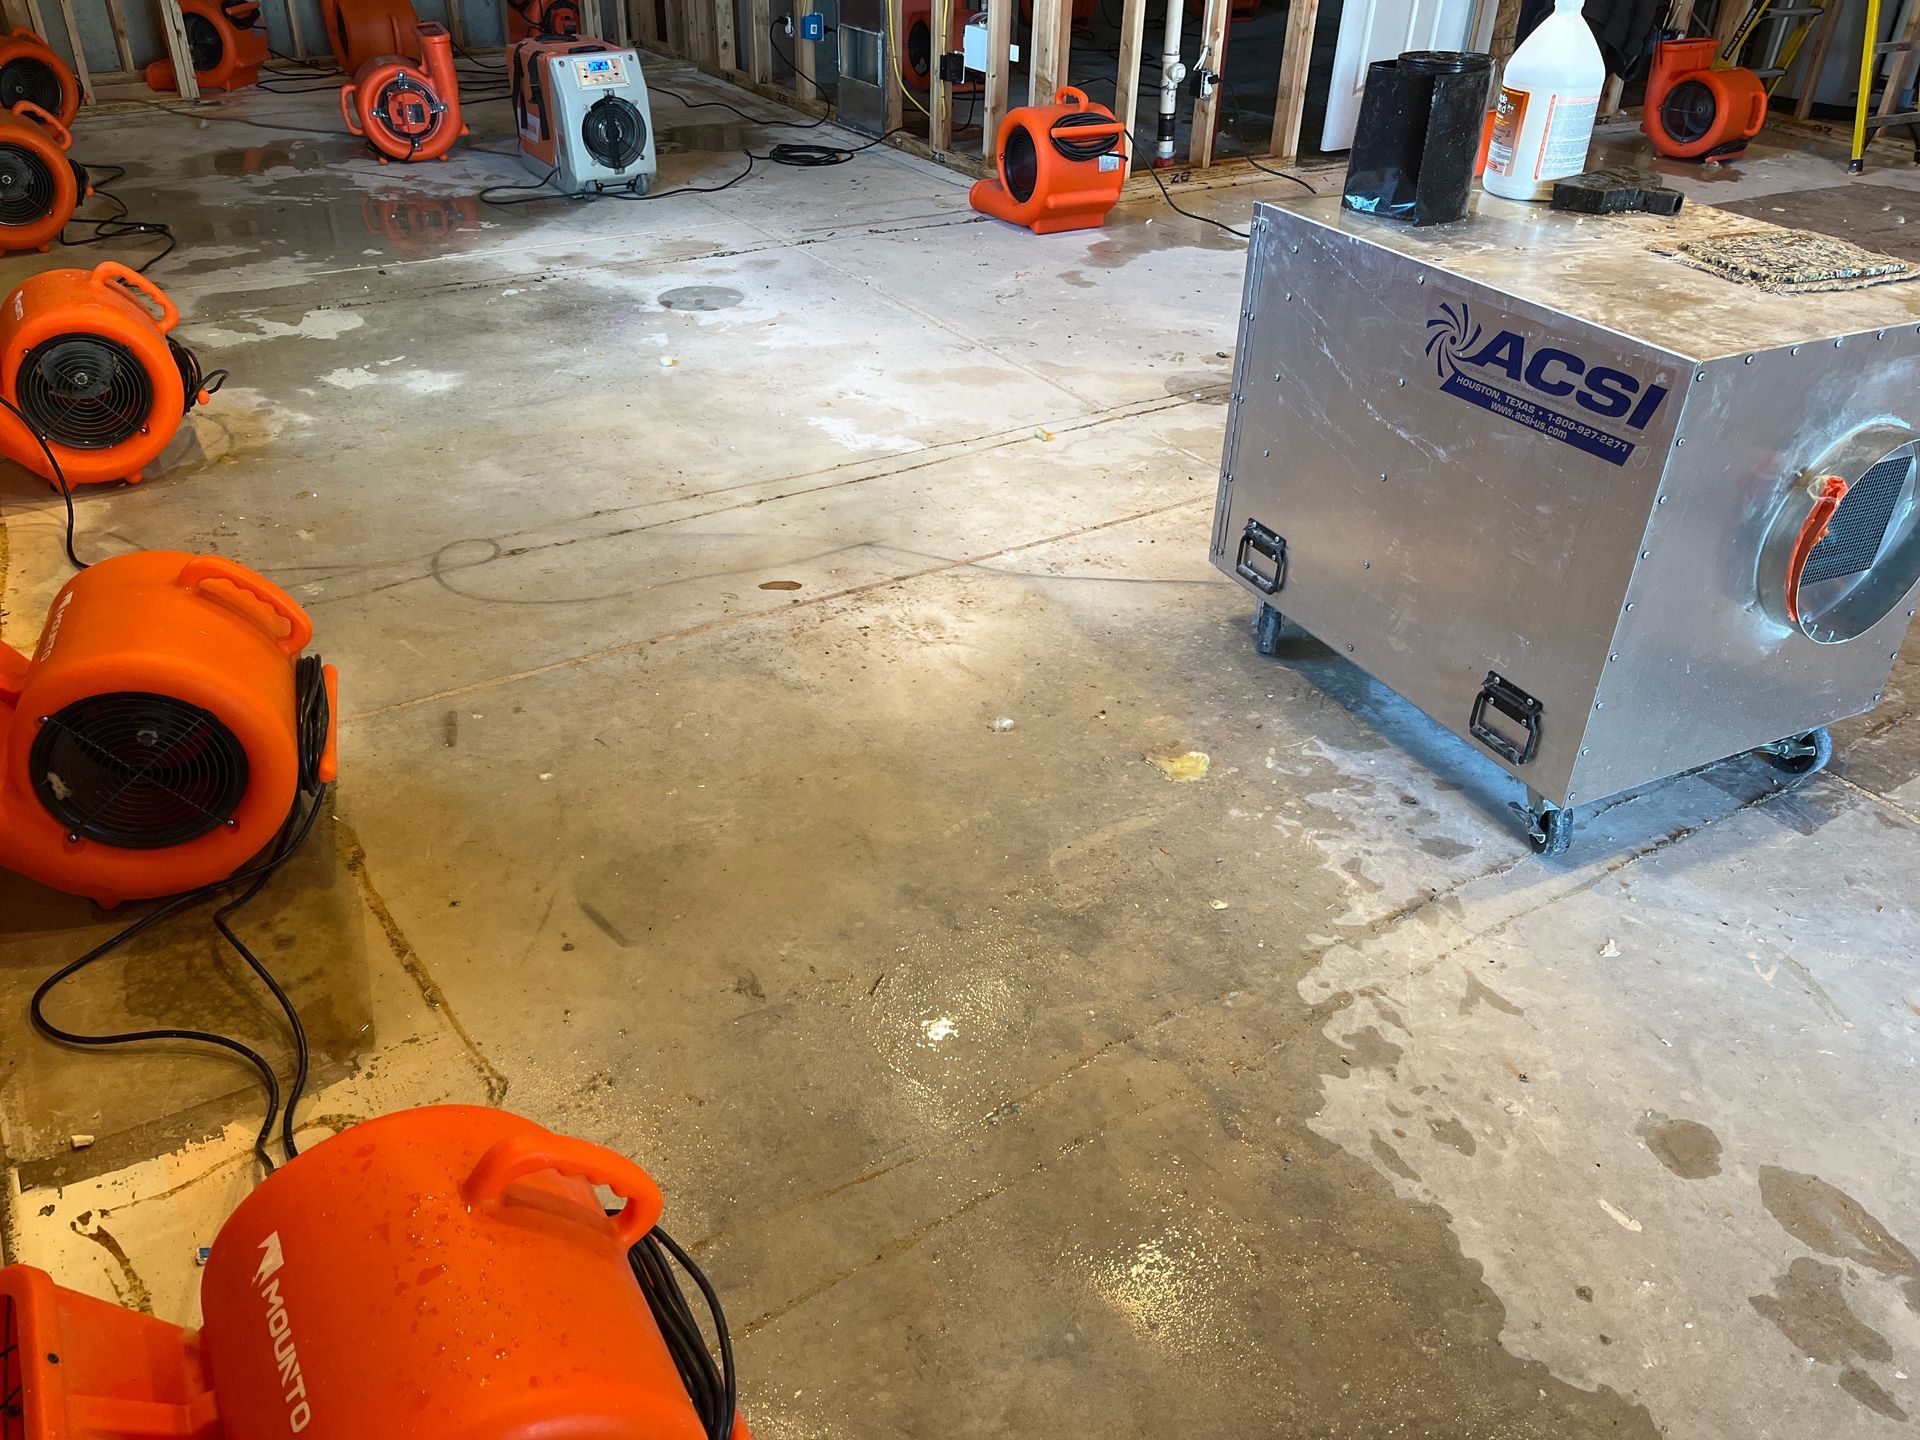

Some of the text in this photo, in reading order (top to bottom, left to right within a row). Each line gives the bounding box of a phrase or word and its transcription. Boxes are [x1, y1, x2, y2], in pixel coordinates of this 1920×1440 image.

[1456, 375, 1629, 453] HOUSTON, TEXAS 1-800-927-2271
[1458, 329, 1668, 431] ACSI
[1490, 401, 1568, 441] www.acsi-us.com
[261, 1279, 311, 1433] MOUNTO
